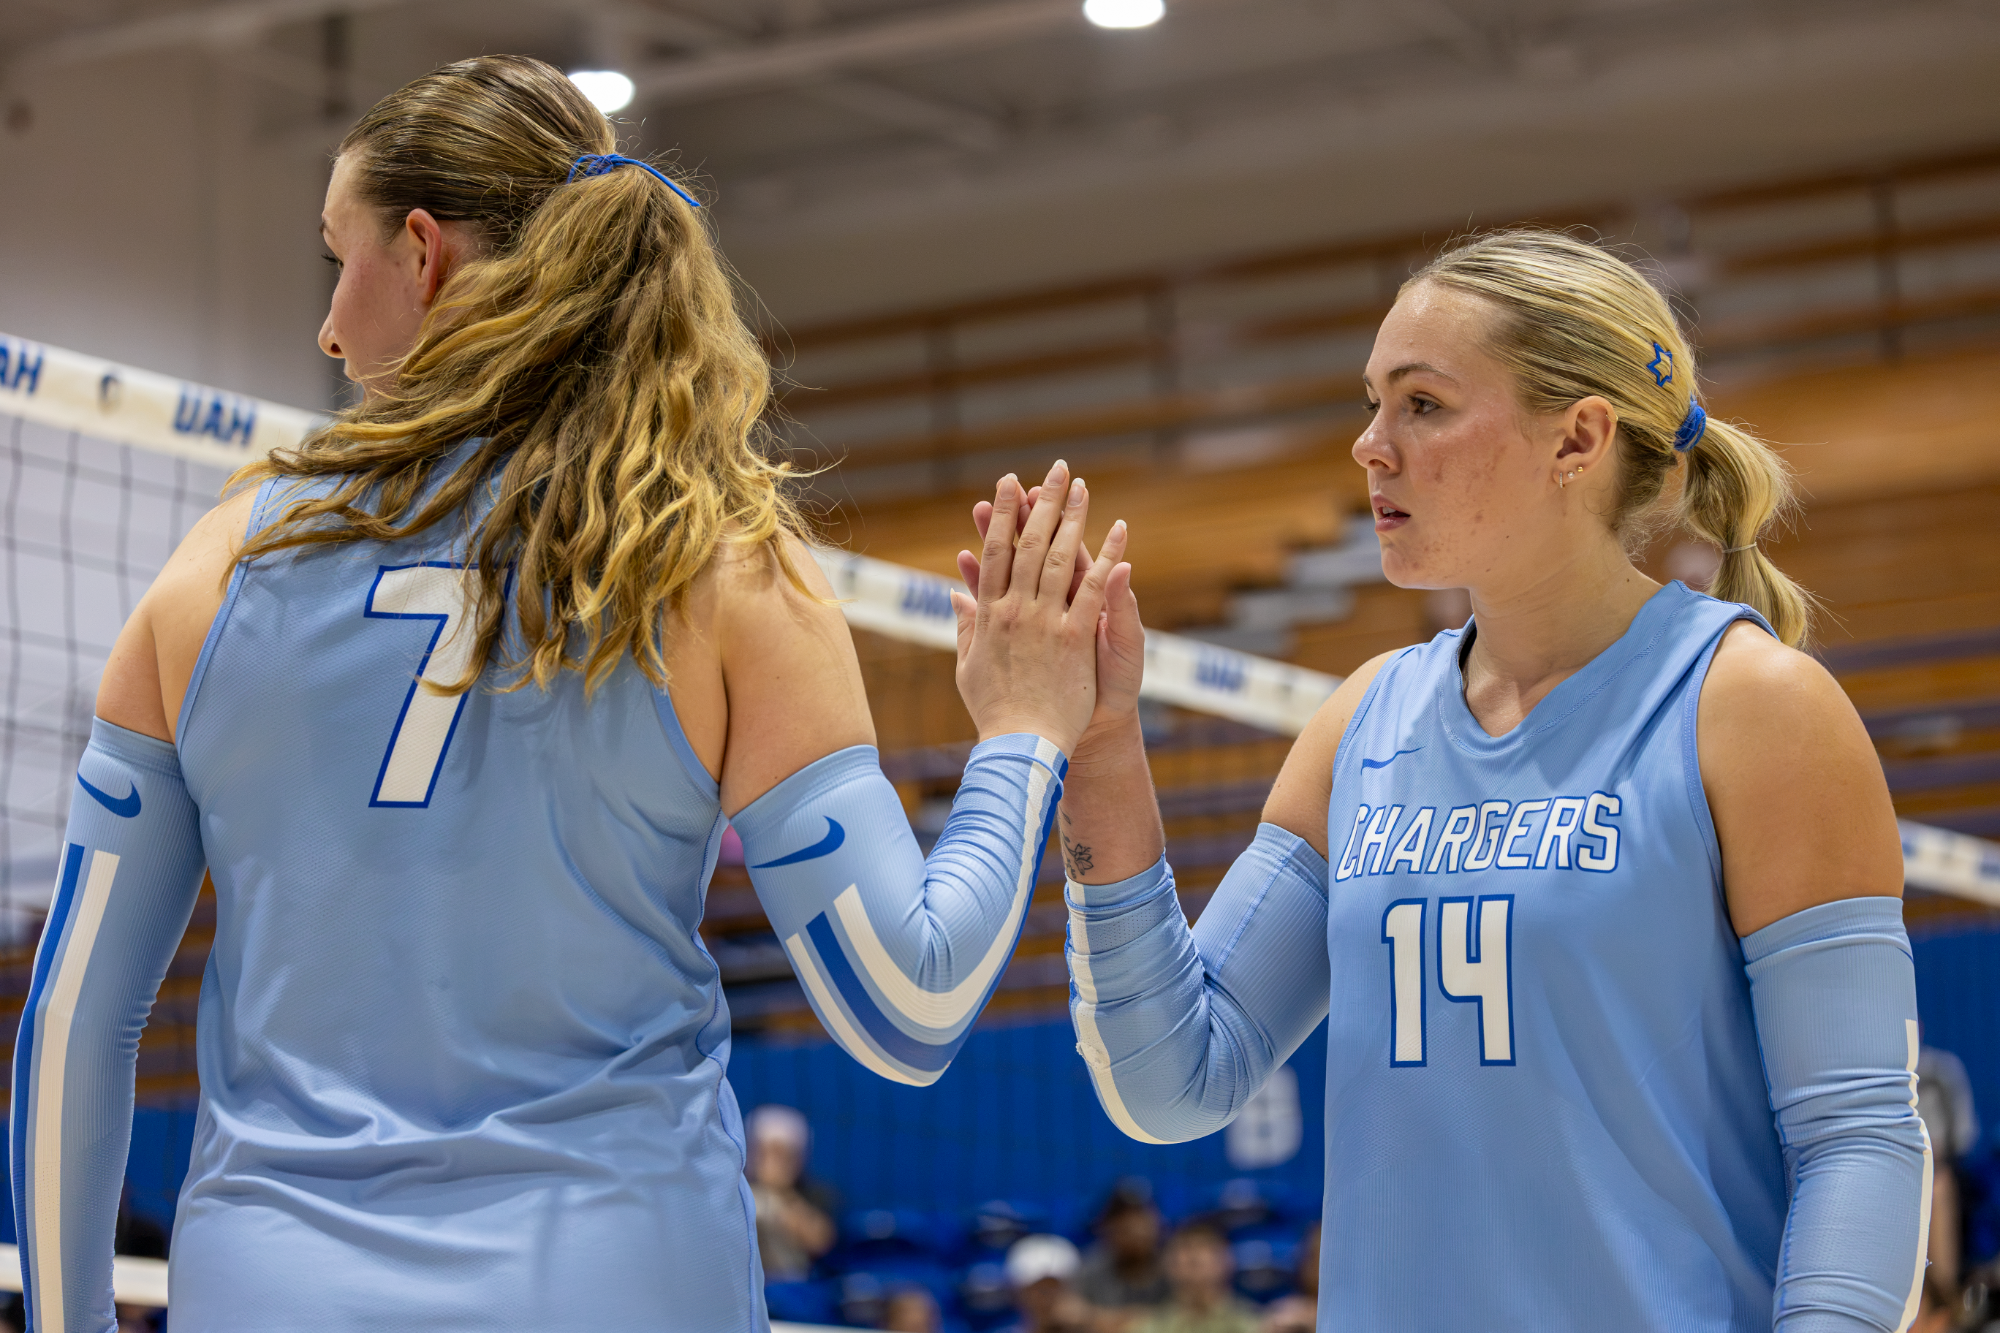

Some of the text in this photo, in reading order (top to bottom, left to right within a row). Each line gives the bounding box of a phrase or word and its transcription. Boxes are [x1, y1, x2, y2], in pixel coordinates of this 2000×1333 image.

[173, 391, 258, 447] UAH
[363, 561, 516, 808] 7
[1335, 790, 1621, 882] CHARGERS
[1381, 894, 1516, 1068] 14
